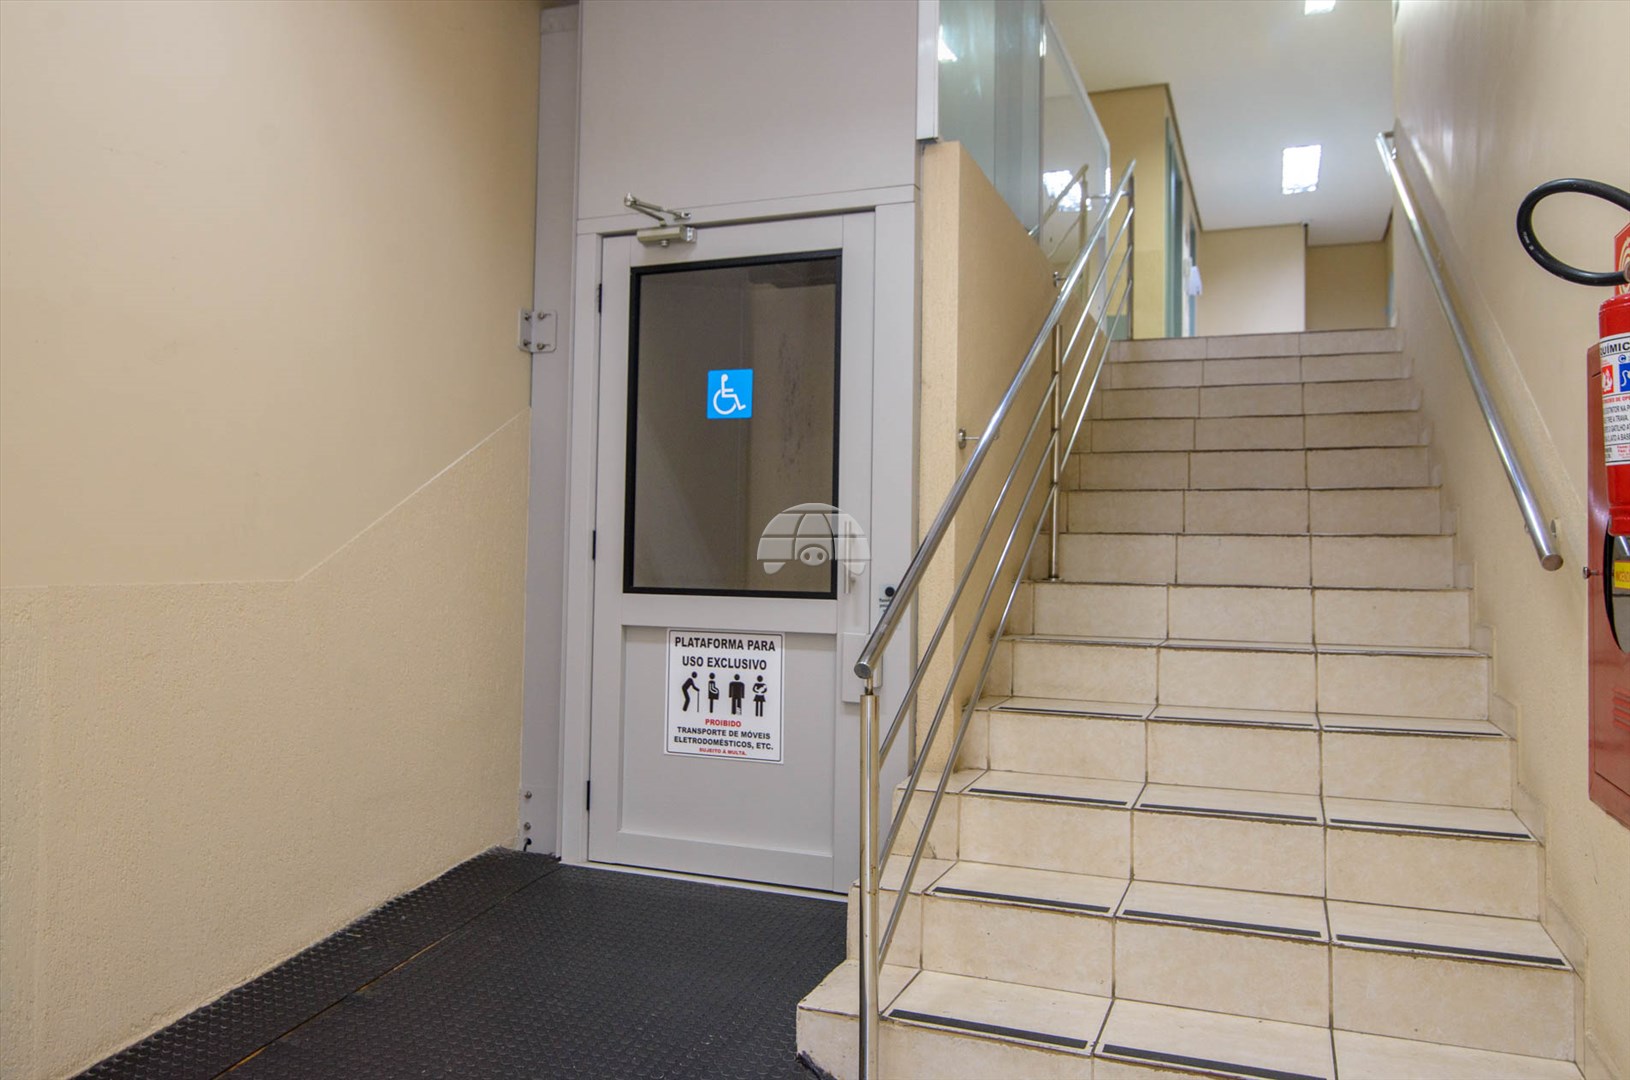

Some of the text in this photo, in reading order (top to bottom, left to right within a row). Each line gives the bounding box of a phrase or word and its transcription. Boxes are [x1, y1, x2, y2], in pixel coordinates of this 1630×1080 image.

[675, 636, 776, 651] PLATAFORMA PARA
[682, 655, 767, 670] USO EXCLUSIVO
[705, 718, 742, 728] PROIBIDO
[677, 726, 771, 740] TRANSPORTE DE MÓVEIS
[674, 735, 774, 751] ELETRODOMÉSTICOS, ETC.
